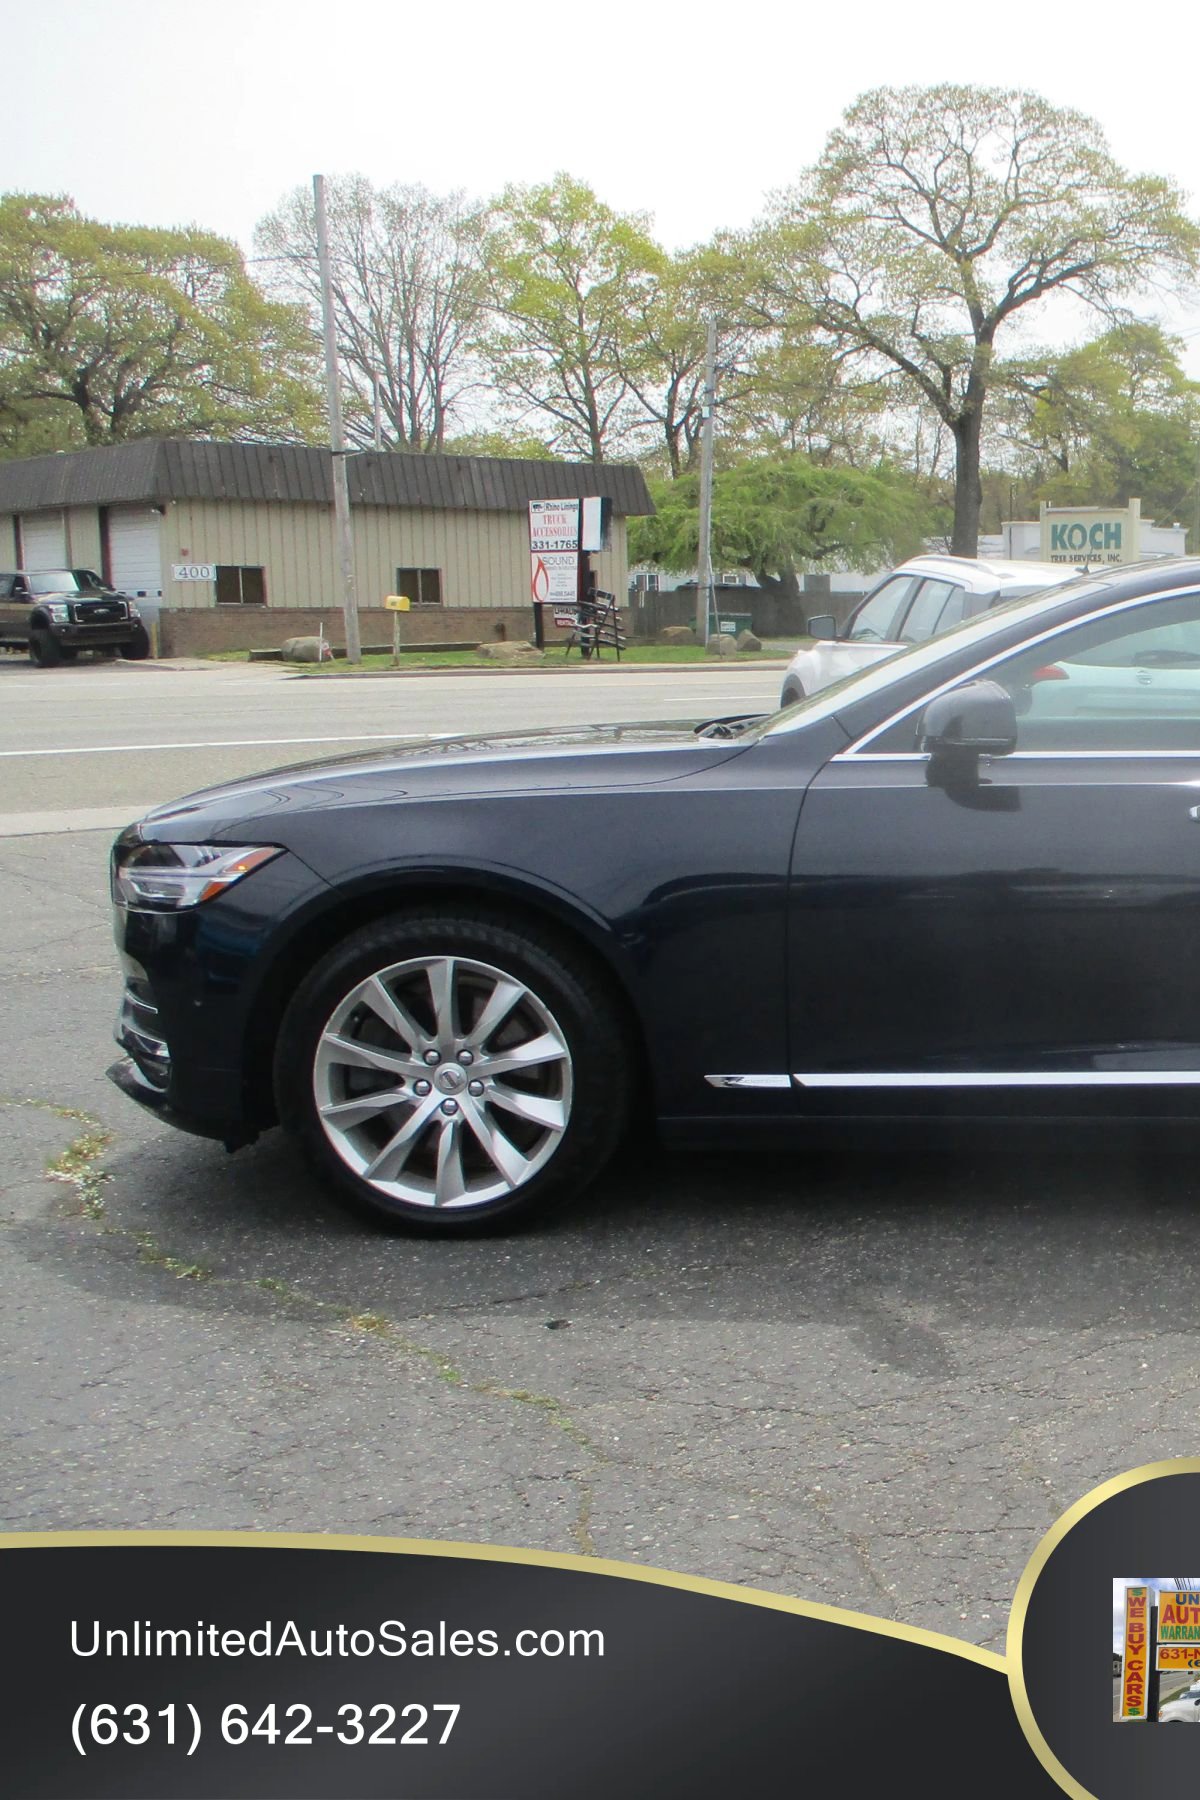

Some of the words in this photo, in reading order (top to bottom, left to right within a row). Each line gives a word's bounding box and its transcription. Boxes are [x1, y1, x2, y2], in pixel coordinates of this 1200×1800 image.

[543, 514, 567, 525] TRUCK
[532, 526, 577, 537] ACCESSORIES
[1051, 523, 1122, 550] KOCH
[532, 540, 578, 549] 331-1765
[543, 556, 575, 566] SOUND
[179, 567, 210, 578] 400
